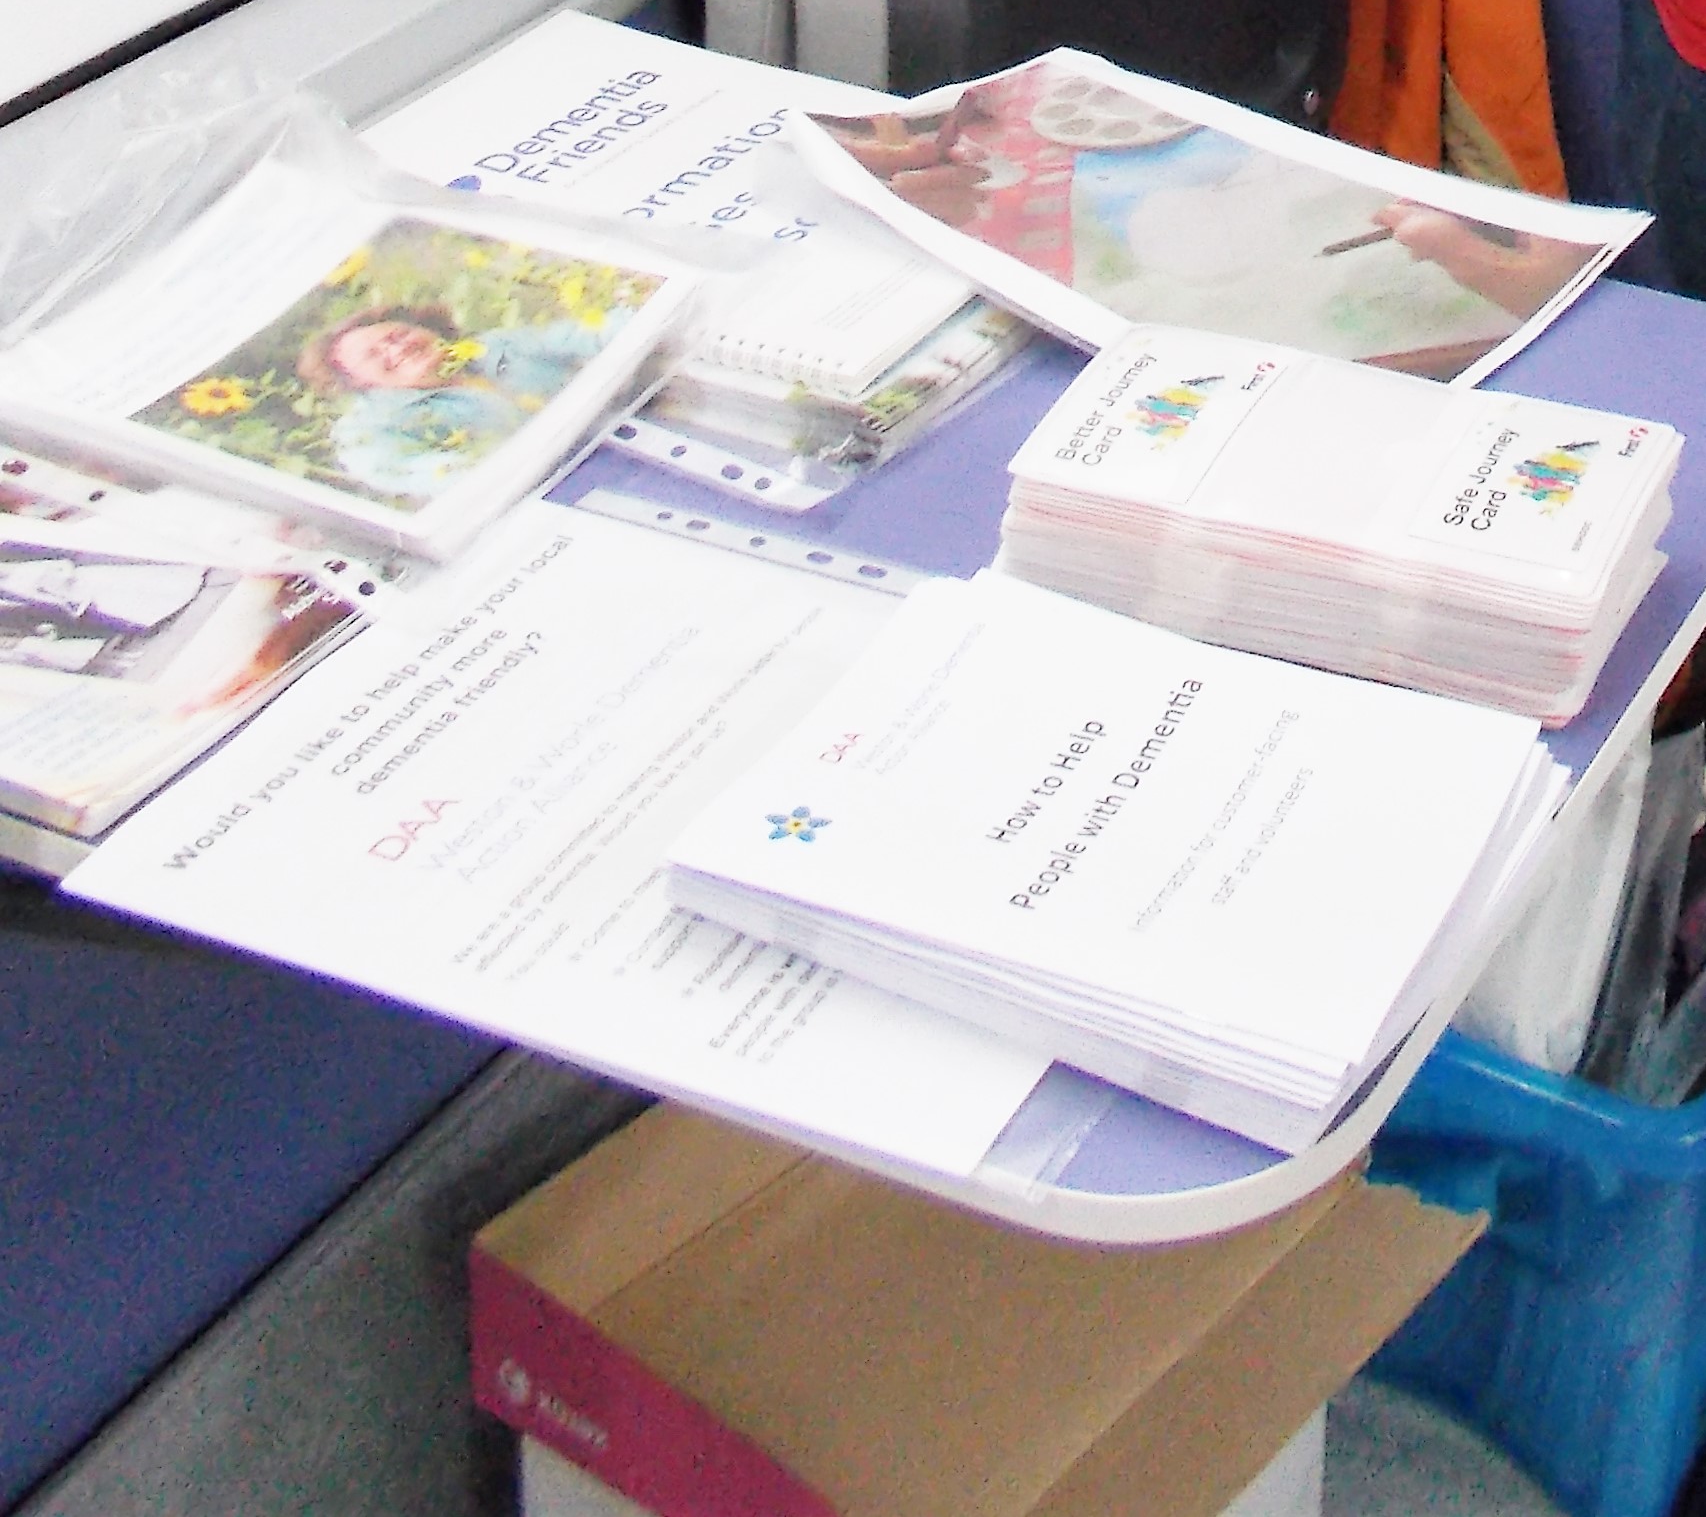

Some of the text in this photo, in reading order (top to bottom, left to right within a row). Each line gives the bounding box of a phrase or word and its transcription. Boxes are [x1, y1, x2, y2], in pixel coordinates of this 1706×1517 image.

[473, 69, 663, 174] Dementia
[515, 99, 670, 185] Friends
[1053, 351, 1158, 461] Better Journey
[1080, 424, 1123, 466] Card
[1442, 427, 1521, 526] Safe Journey
[1469, 488, 1508, 531] Card
[162, 533, 574, 870] Would you like to help make your local
[330, 628, 508, 777] community more
[355, 630, 543, 795] dementia friendly?
[366, 798, 460, 863] DAA
[984, 719, 1107, 843] How to Help
[1007, 678, 1204, 910] People with Dementia
